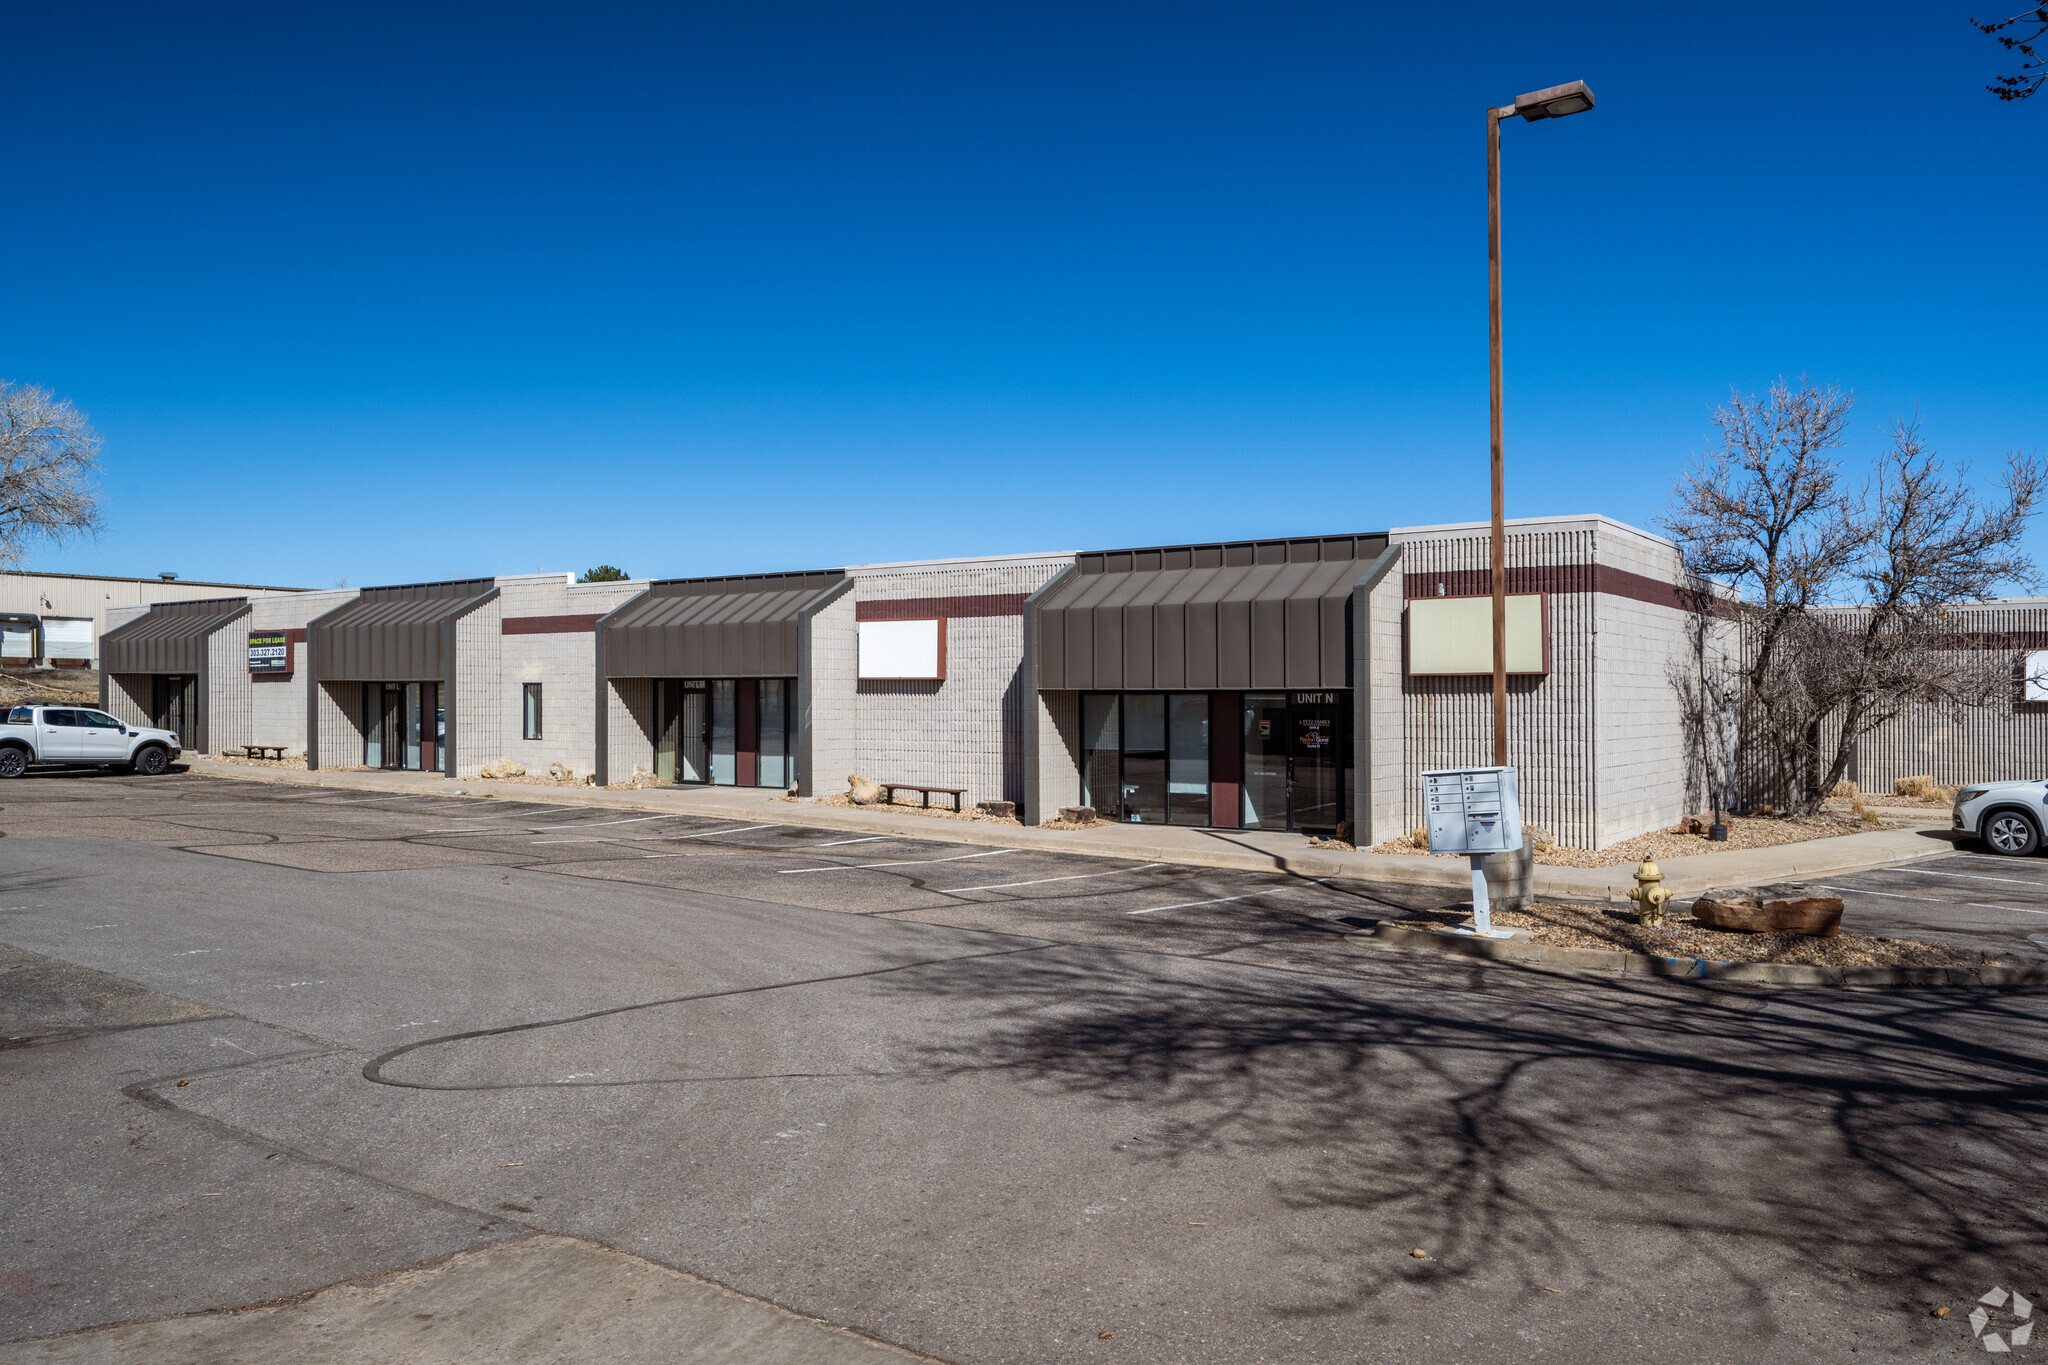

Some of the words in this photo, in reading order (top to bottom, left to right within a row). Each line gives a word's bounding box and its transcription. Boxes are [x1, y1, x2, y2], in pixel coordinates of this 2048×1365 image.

[250, 648, 284, 657] 303.327.2120
[684, 680, 698, 688] UNIT
[1297, 693, 1322, 704] UNIT
[1325, 693, 1333, 704] N
